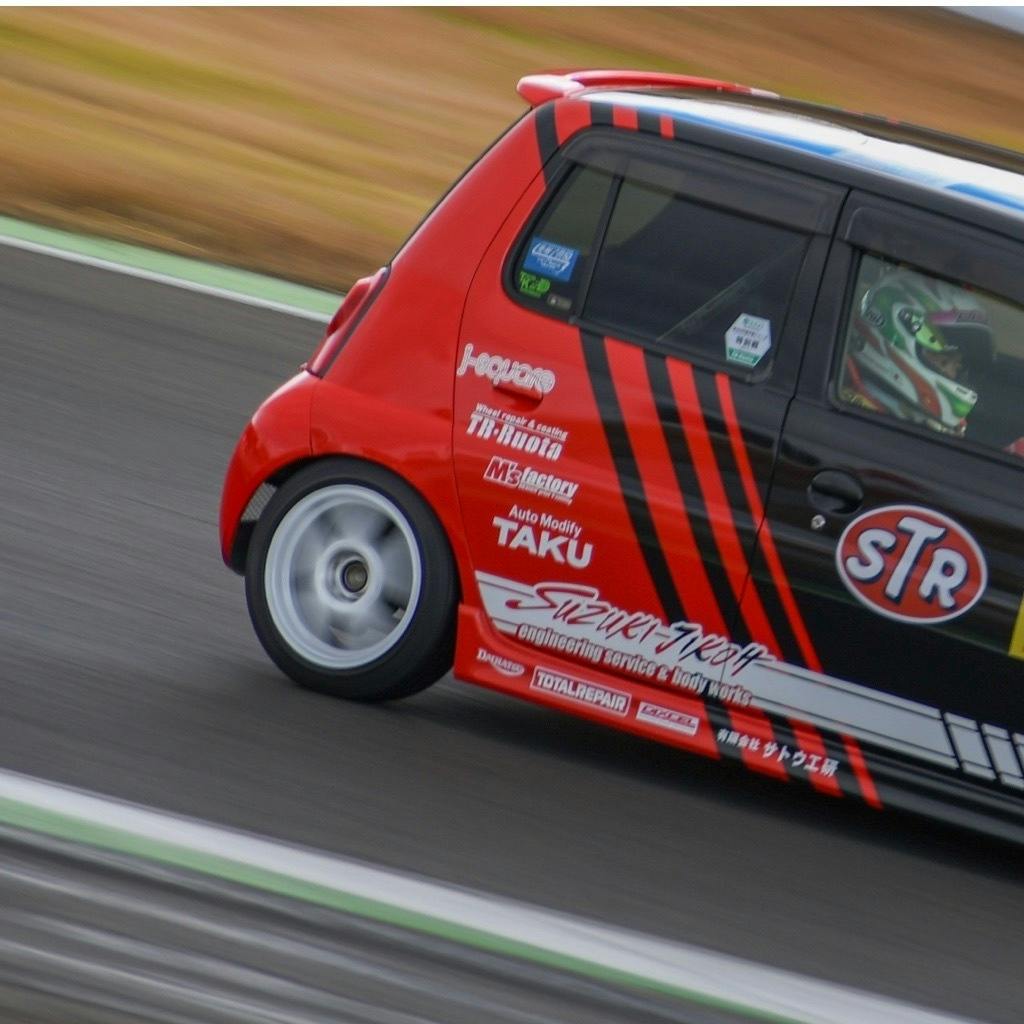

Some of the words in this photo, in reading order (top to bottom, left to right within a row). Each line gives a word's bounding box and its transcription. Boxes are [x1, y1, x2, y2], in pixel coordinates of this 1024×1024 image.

[457, 343, 556, 393] j-square
[475, 403, 501, 419] Wheel
[501, 411, 528, 427] repair
[536, 423, 570, 442] coating
[483, 456, 522, 488] M's
[520, 466, 579, 500] factory
[492, 516, 593, 569] TAKU
[509, 504, 538, 525] Auto
[539, 512, 582, 538] Modify
[845, 517, 968, 609] STR
[517, 623, 602, 663] engineering
[603, 647, 656, 677] service
[672, 664, 708, 694] body
[708, 681, 754, 708] works
[762, 741, 840, 778] サトウ工研
